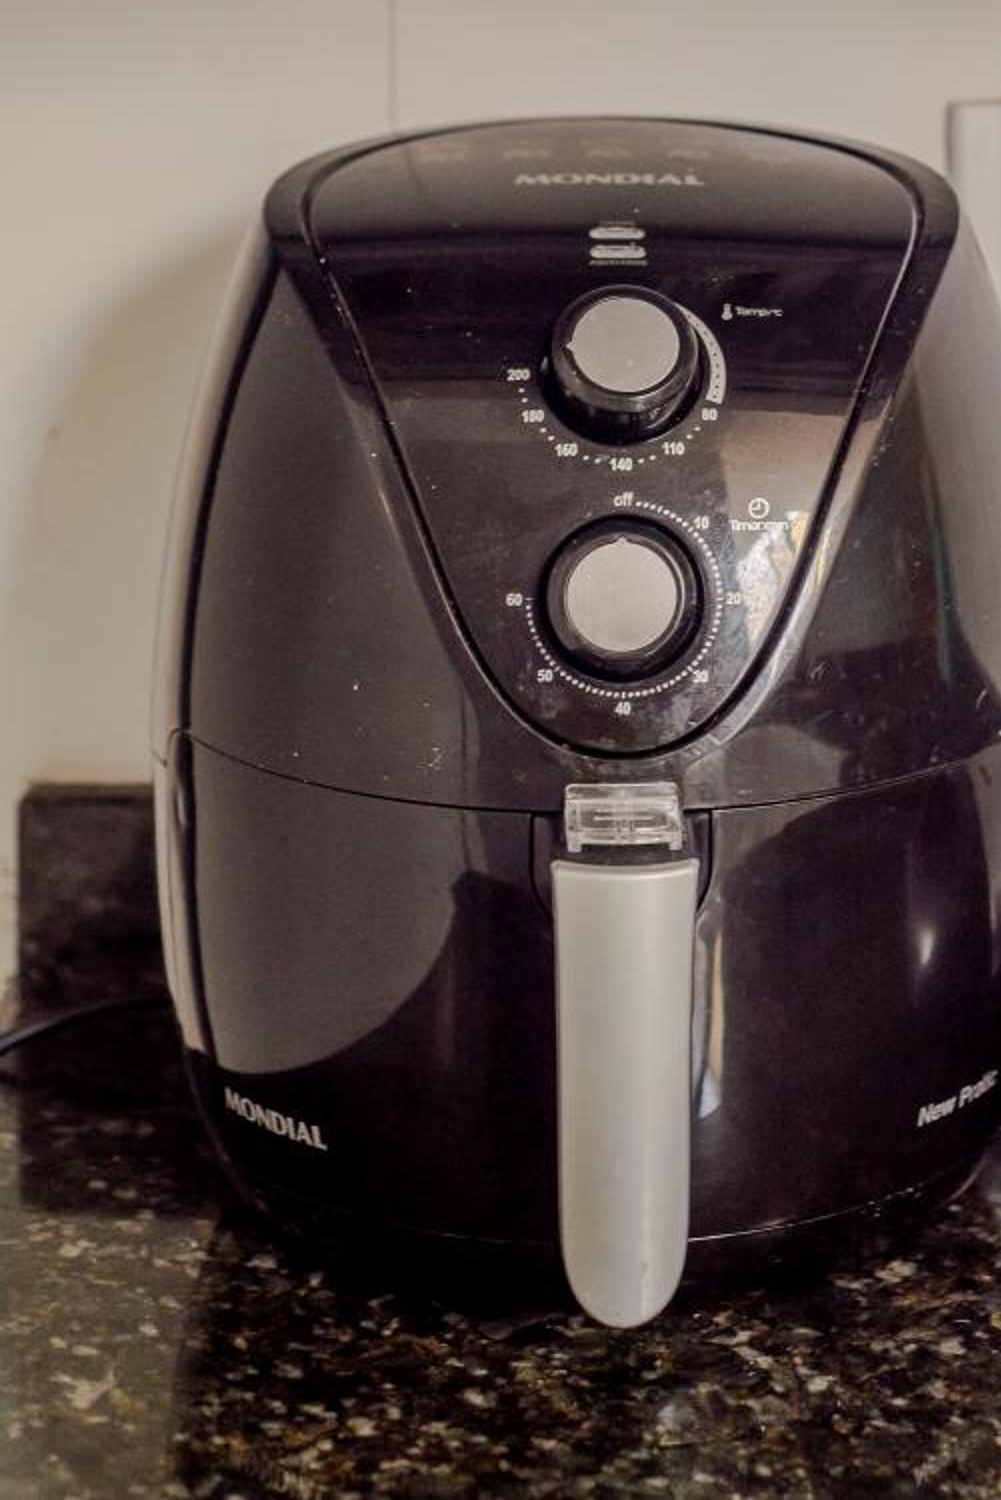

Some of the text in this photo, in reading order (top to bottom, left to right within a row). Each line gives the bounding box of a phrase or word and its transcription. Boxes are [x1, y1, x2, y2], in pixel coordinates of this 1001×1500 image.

[515, 173, 704, 186] MONDIAL
[507, 368, 530, 381] 200
[522, 410, 544, 422] 180
[702, 408, 717, 421] 80
[555, 443, 578, 456] 160
[662, 442, 685, 455] 110
[609, 458, 633, 471] 140
[613, 492, 634, 507] off
[694, 516, 709, 529] 10
[506, 593, 523, 606] 60
[727, 592, 741, 605] 20
[537, 670, 553, 683] 50
[693, 670, 708, 683] 30
[615, 701, 631, 715] 40
[224, 1086, 328, 1151] MONDIAL
